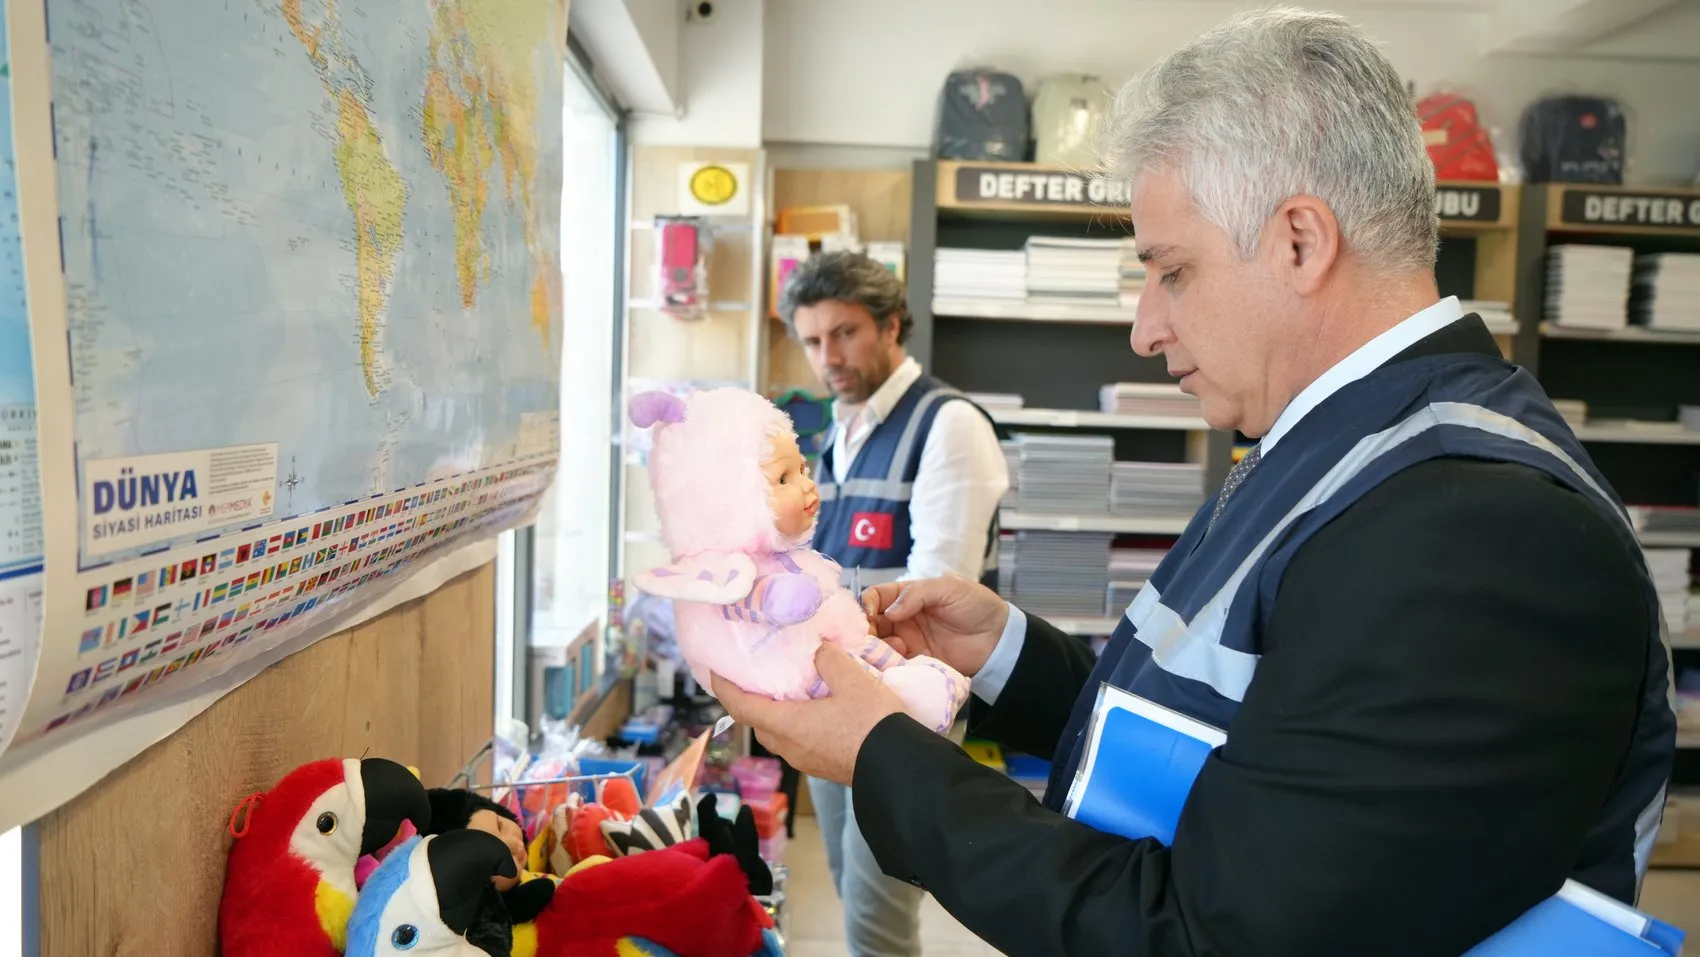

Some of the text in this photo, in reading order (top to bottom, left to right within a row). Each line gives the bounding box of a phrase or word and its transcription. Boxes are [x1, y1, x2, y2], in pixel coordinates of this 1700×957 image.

[979, 172, 1083, 202] DEFTER
[1584, 195, 1683, 222] DEFTER
[93, 467, 198, 516] DÜNYA
[93, 513, 140, 540] SİYASİ
[144, 505, 203, 529] HARİTASI
